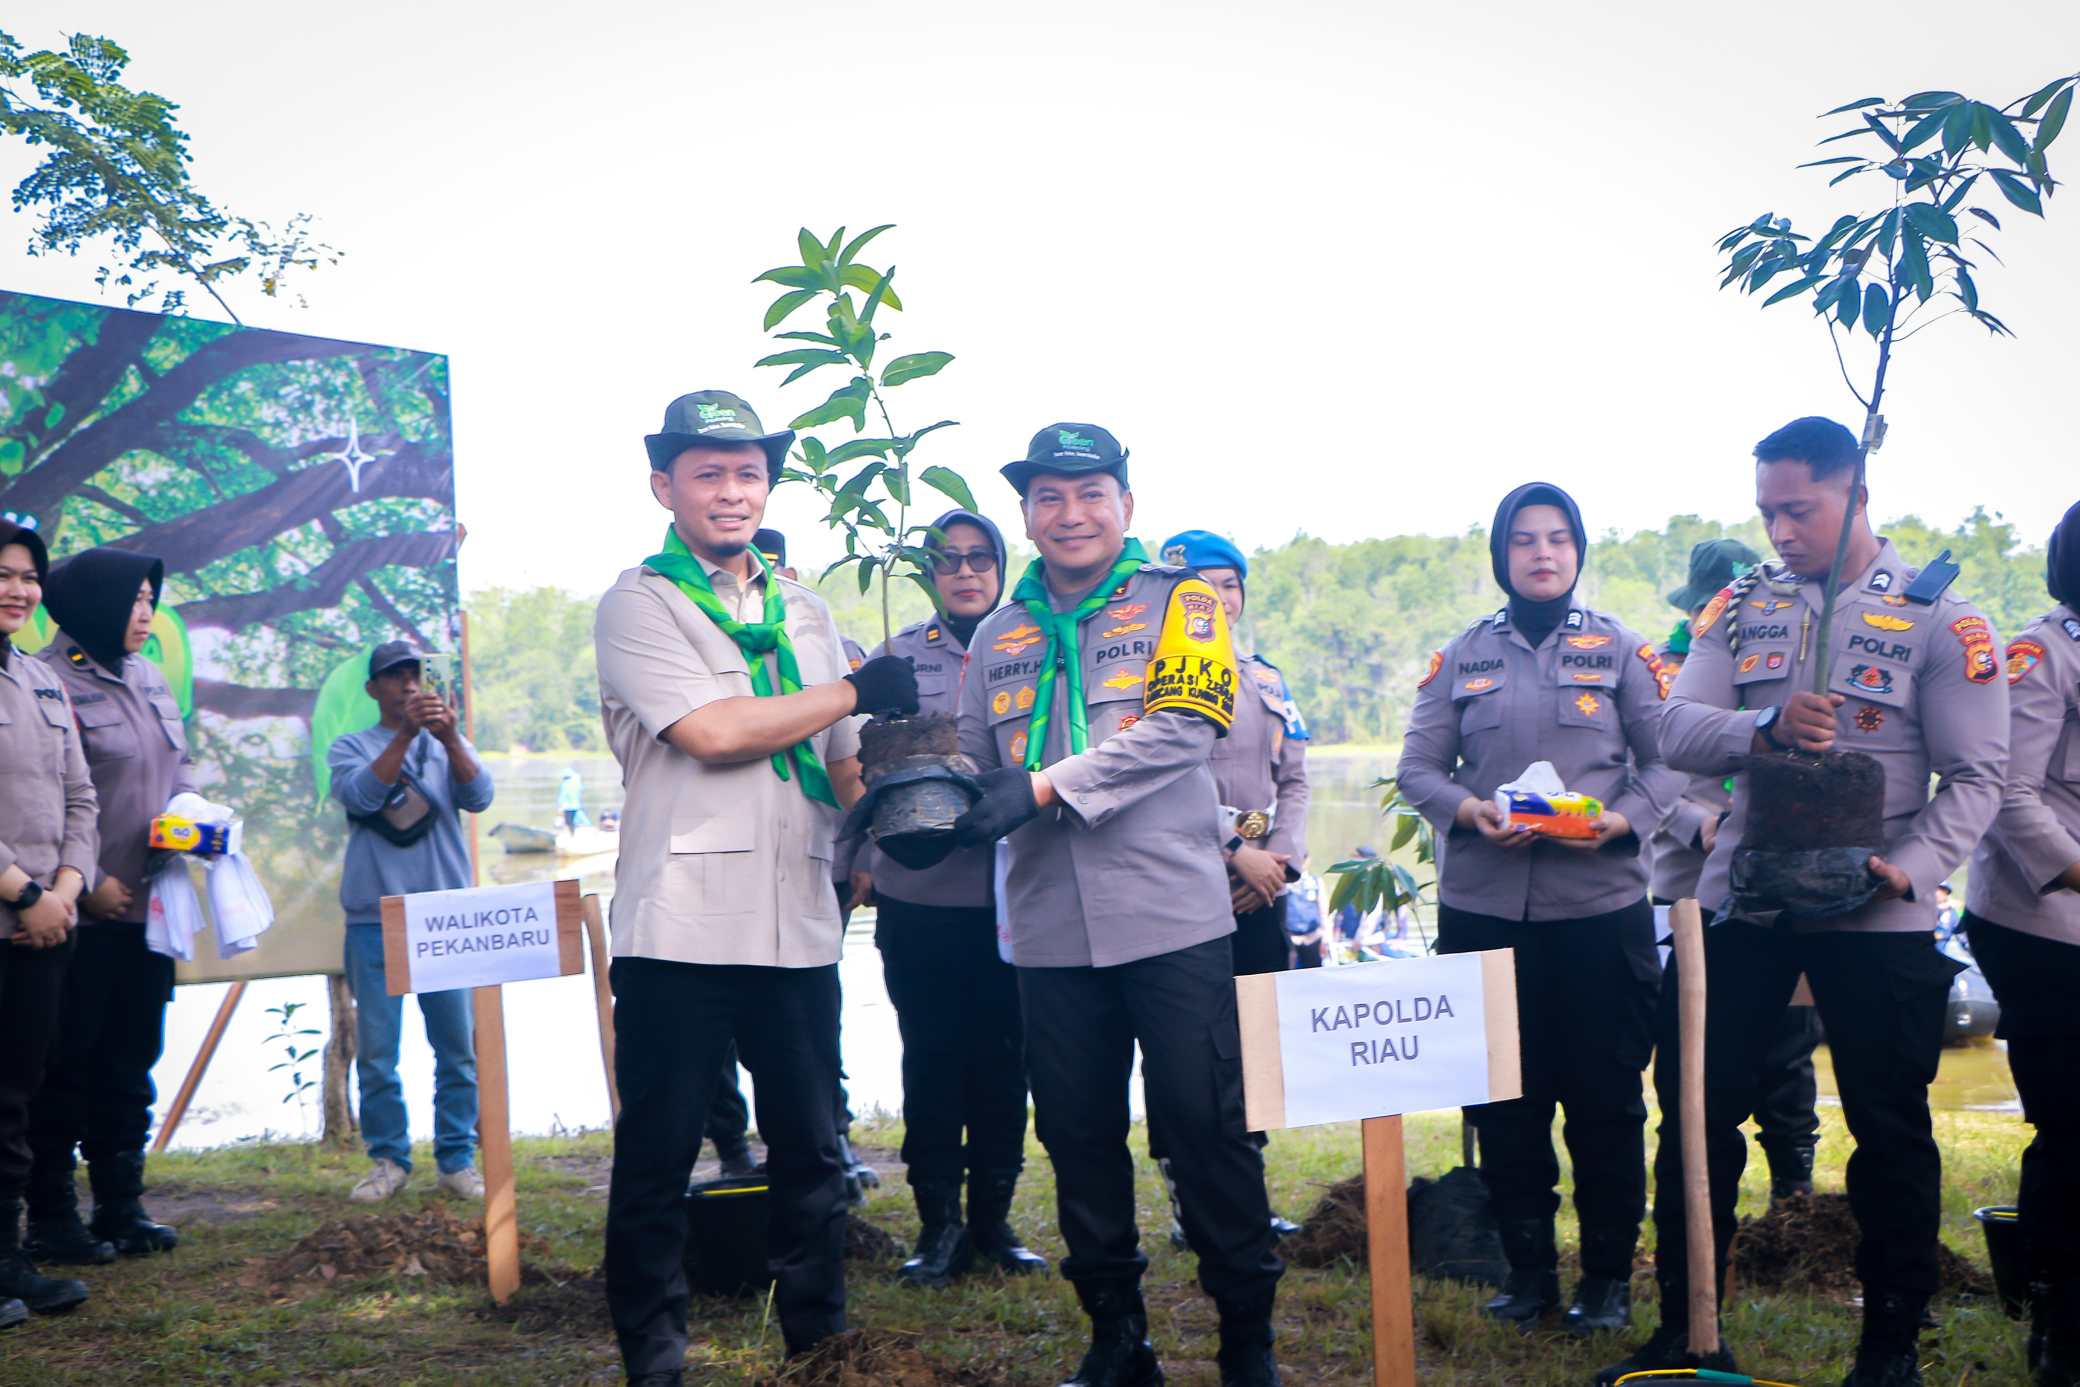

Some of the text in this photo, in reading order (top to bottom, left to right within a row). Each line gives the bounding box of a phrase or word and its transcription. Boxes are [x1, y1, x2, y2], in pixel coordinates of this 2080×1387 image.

[1096, 640, 1153, 663] POLRI
[1562, 655, 1613, 669] POLRI
[1848, 634, 1912, 663] POLRI
[1458, 658, 1504, 675] NADIA
[425, 907, 538, 933] WALIKOTA
[416, 929, 550, 958] PEKANBARU
[1311, 995, 1455, 1033] KAPOLDA
[1351, 1035, 1420, 1067] RIAU
